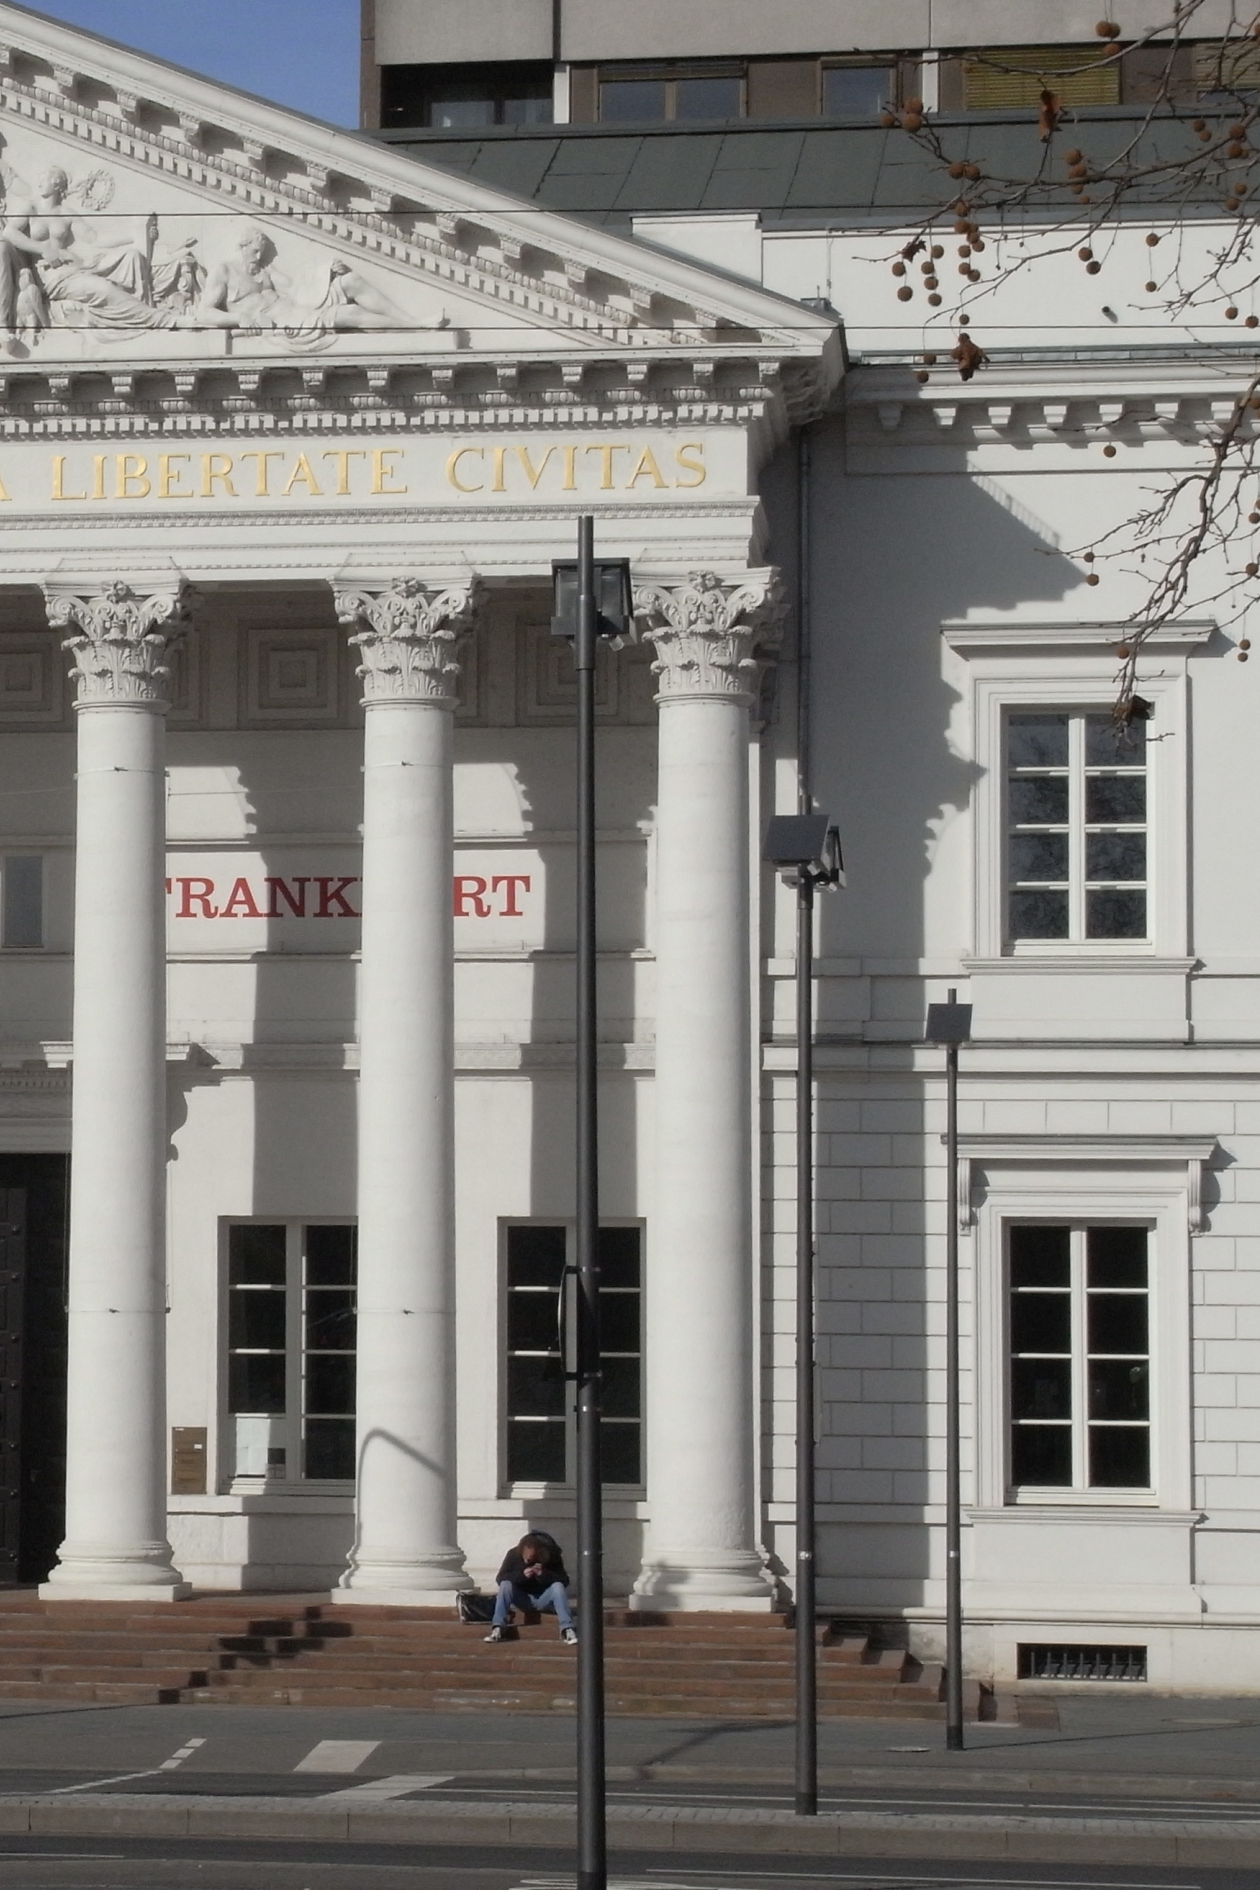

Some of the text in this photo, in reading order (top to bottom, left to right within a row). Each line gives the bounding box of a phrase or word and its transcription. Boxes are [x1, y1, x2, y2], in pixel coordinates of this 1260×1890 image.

[51, 449, 408, 500] LIBERTATE
[446, 443, 707, 492] CIVITAS
[165, 875, 531, 919] RANKRT
